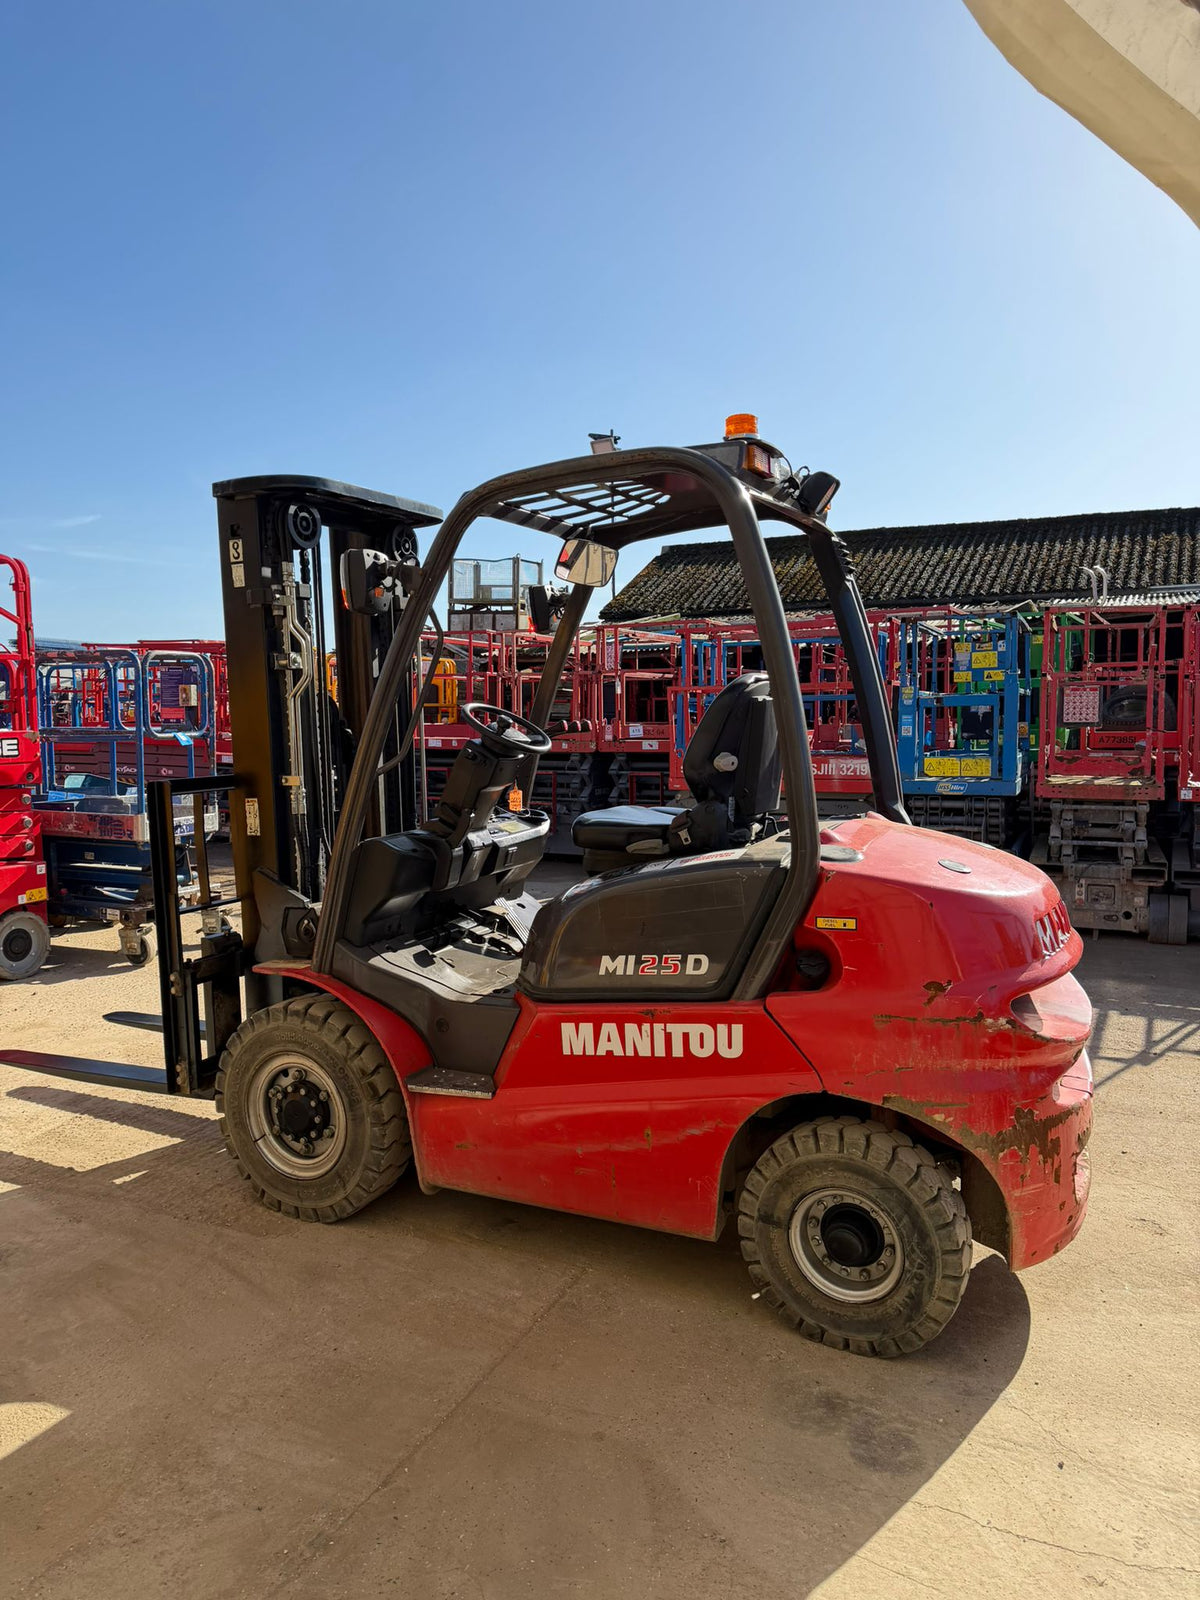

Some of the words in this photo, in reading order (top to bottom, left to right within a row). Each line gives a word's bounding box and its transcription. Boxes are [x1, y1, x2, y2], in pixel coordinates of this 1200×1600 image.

[0, 737, 20, 758] E
[839, 763, 868, 775] 3219
[560, 1022, 744, 1059] MANITOU
